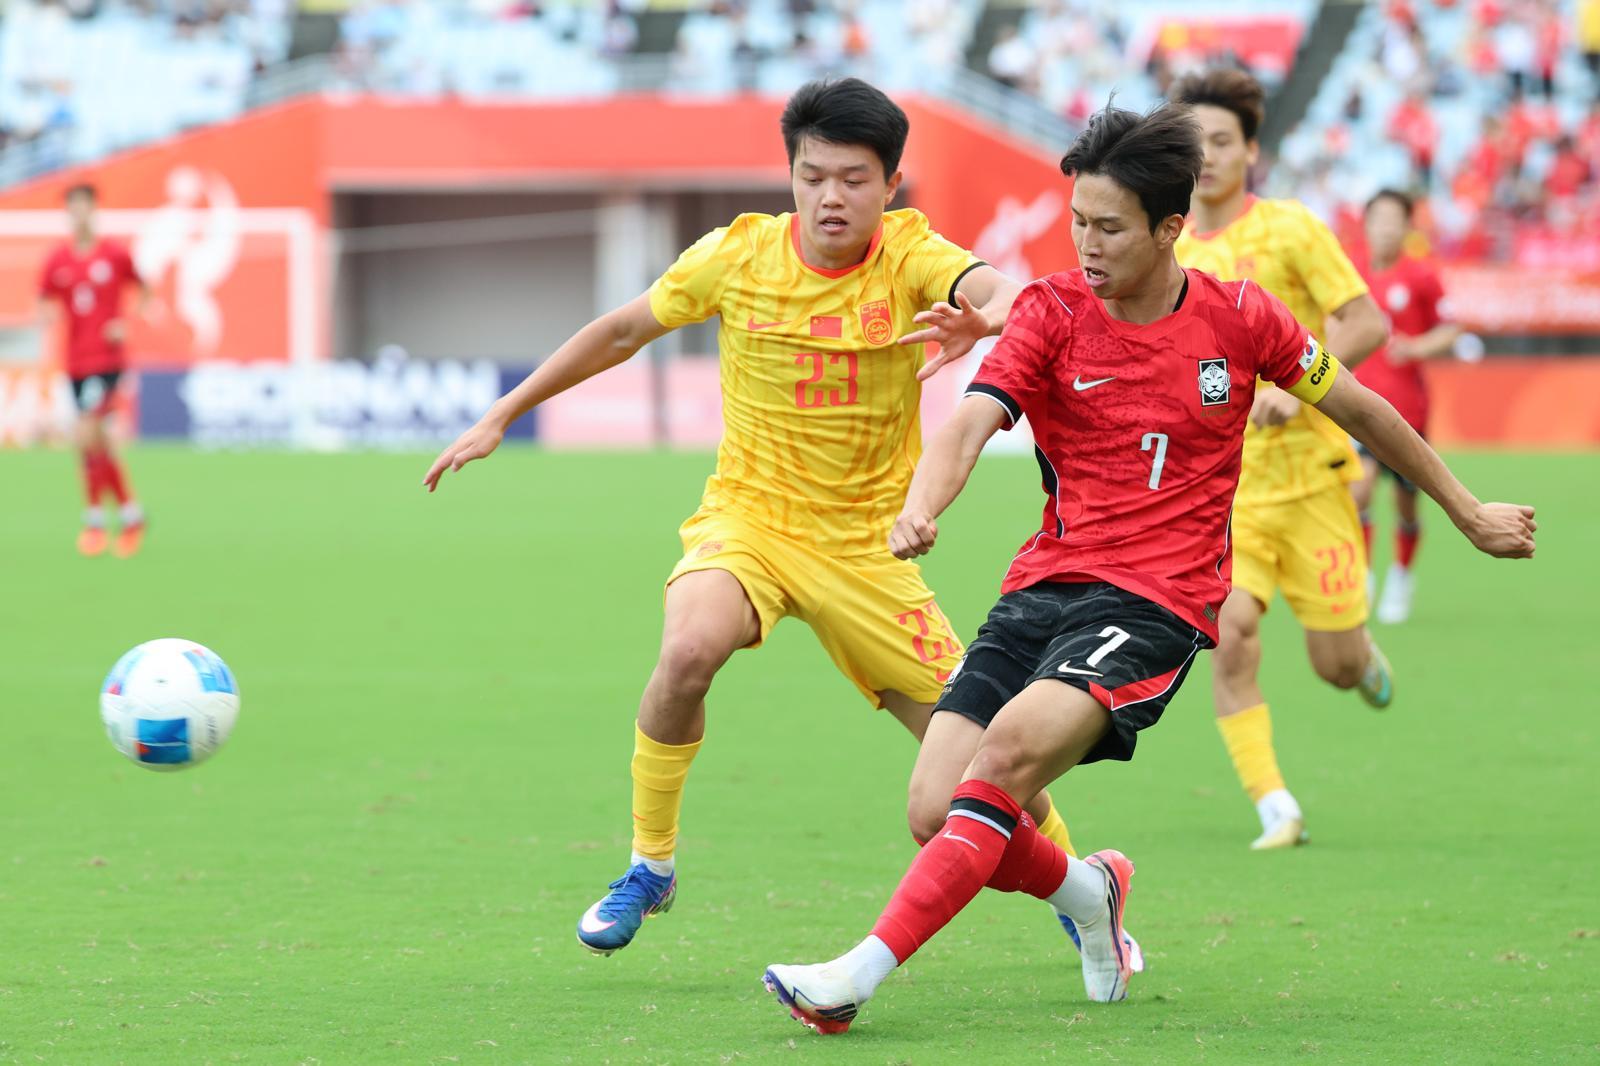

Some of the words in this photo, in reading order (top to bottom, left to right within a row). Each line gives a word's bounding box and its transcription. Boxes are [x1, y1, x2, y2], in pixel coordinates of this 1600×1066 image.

[861, 301, 887, 314] CFA
[792, 352, 861, 408] 23
[1311, 351, 1330, 385] Capt
[1139, 433, 1169, 489] 7
[1086, 625, 1131, 668] 7
